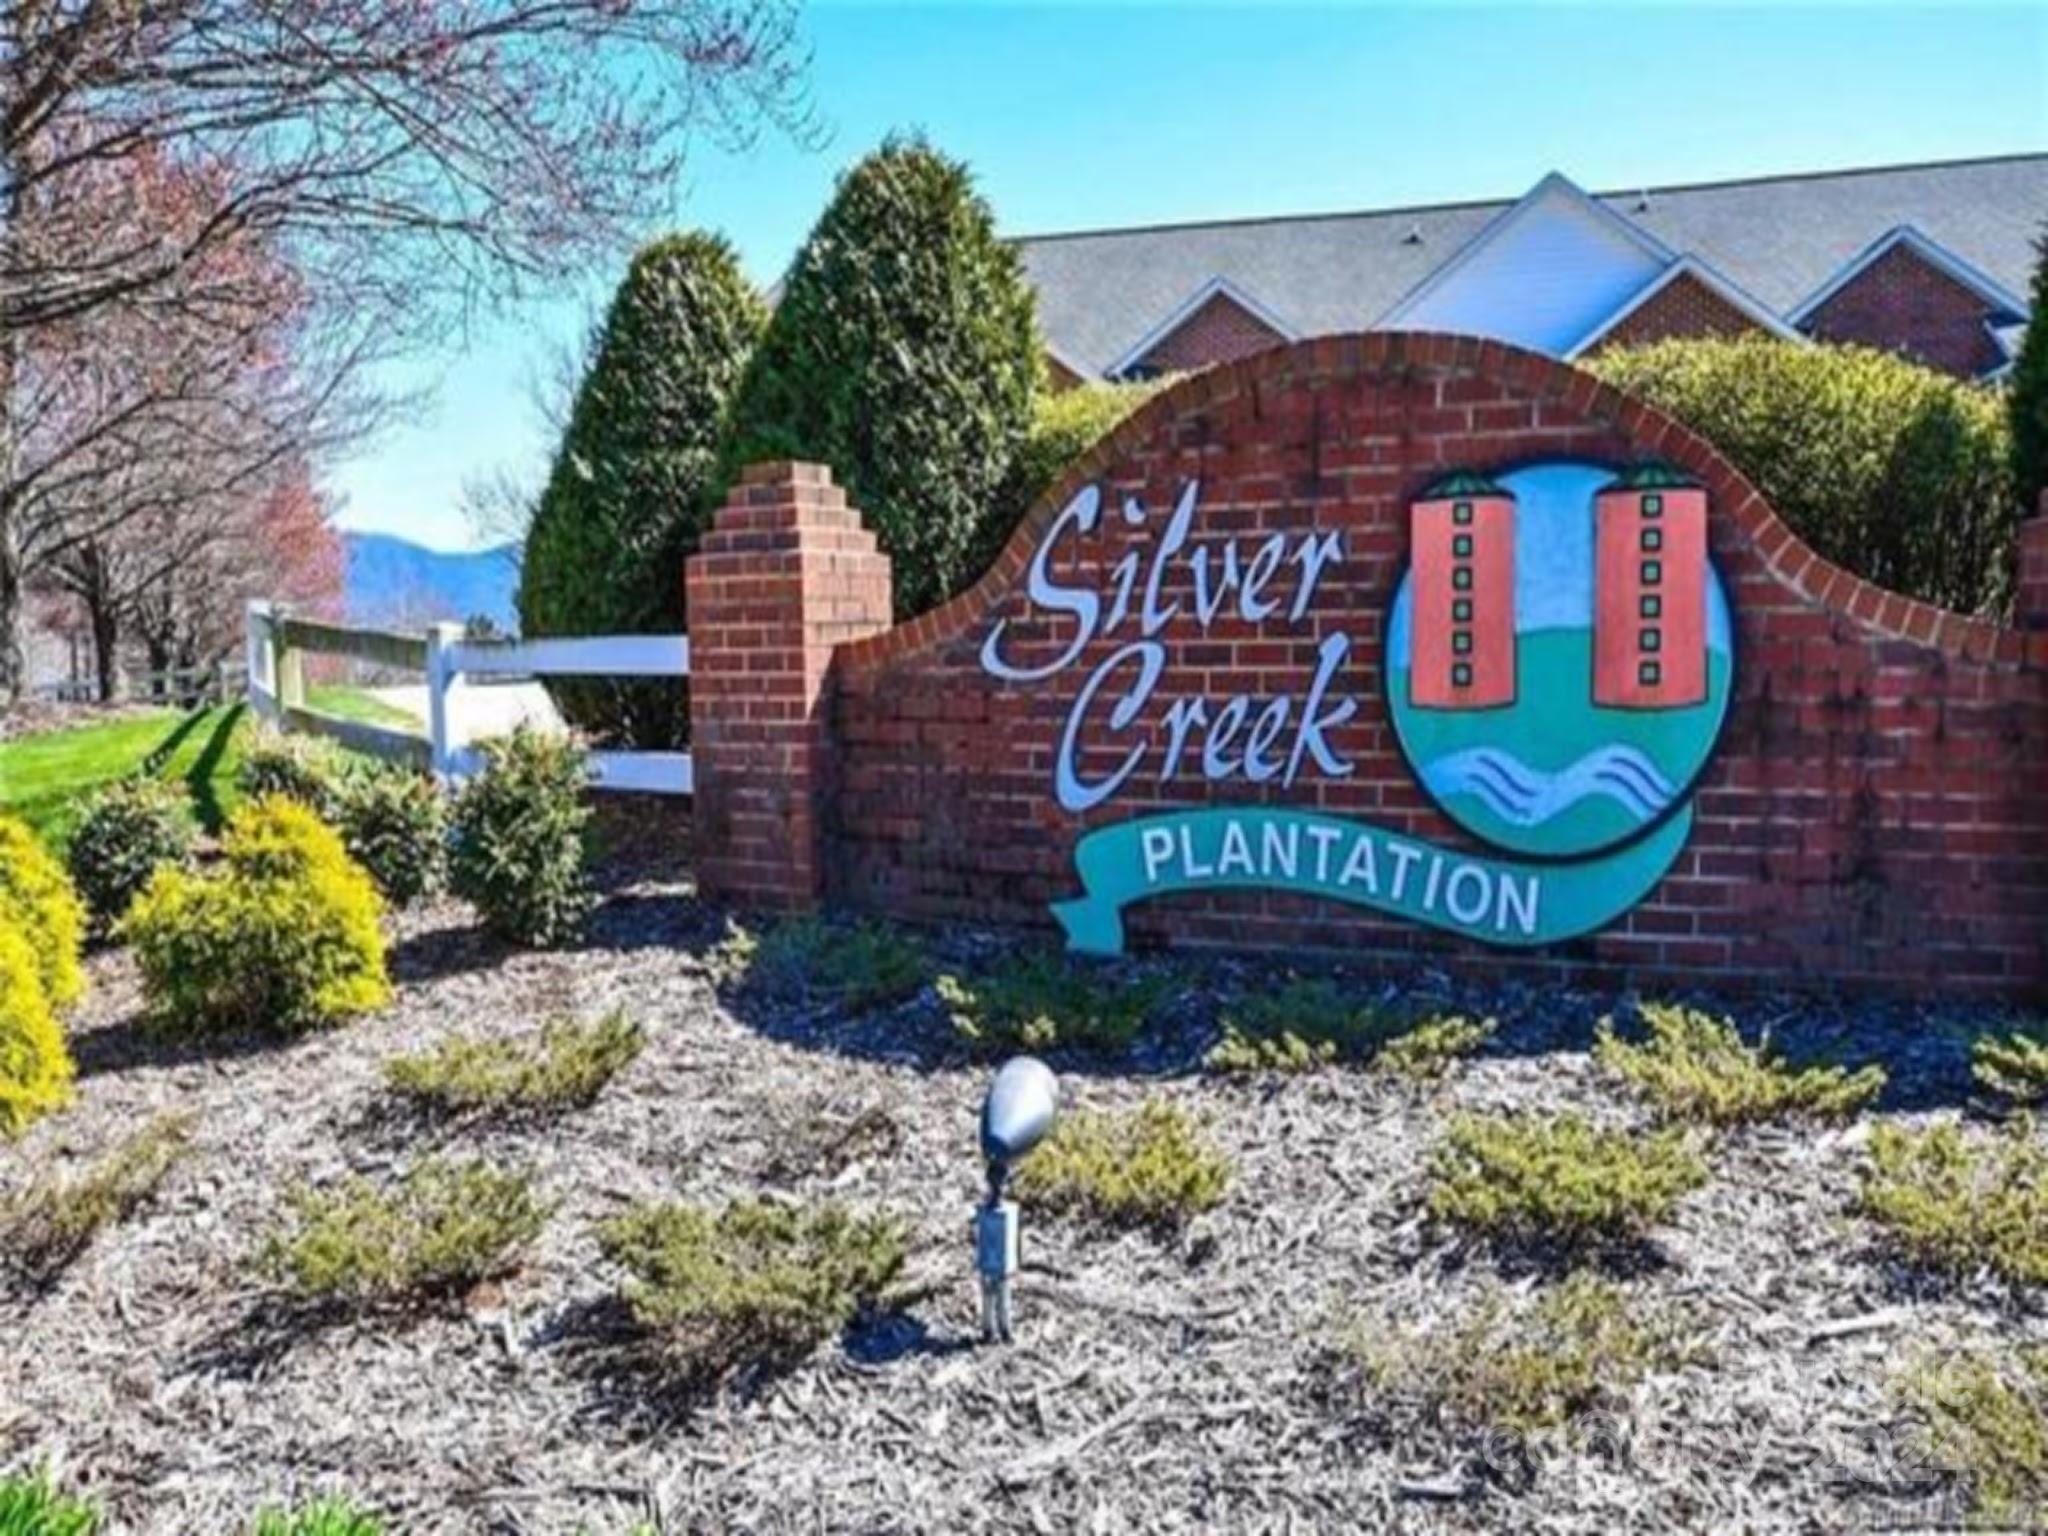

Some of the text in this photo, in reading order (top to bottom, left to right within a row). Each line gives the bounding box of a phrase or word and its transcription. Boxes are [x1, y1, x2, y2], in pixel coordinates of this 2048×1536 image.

[979, 479, 1344, 680] Silver
[1055, 631, 1358, 812] Creek
[1141, 820, 1541, 934] PLANTATION
